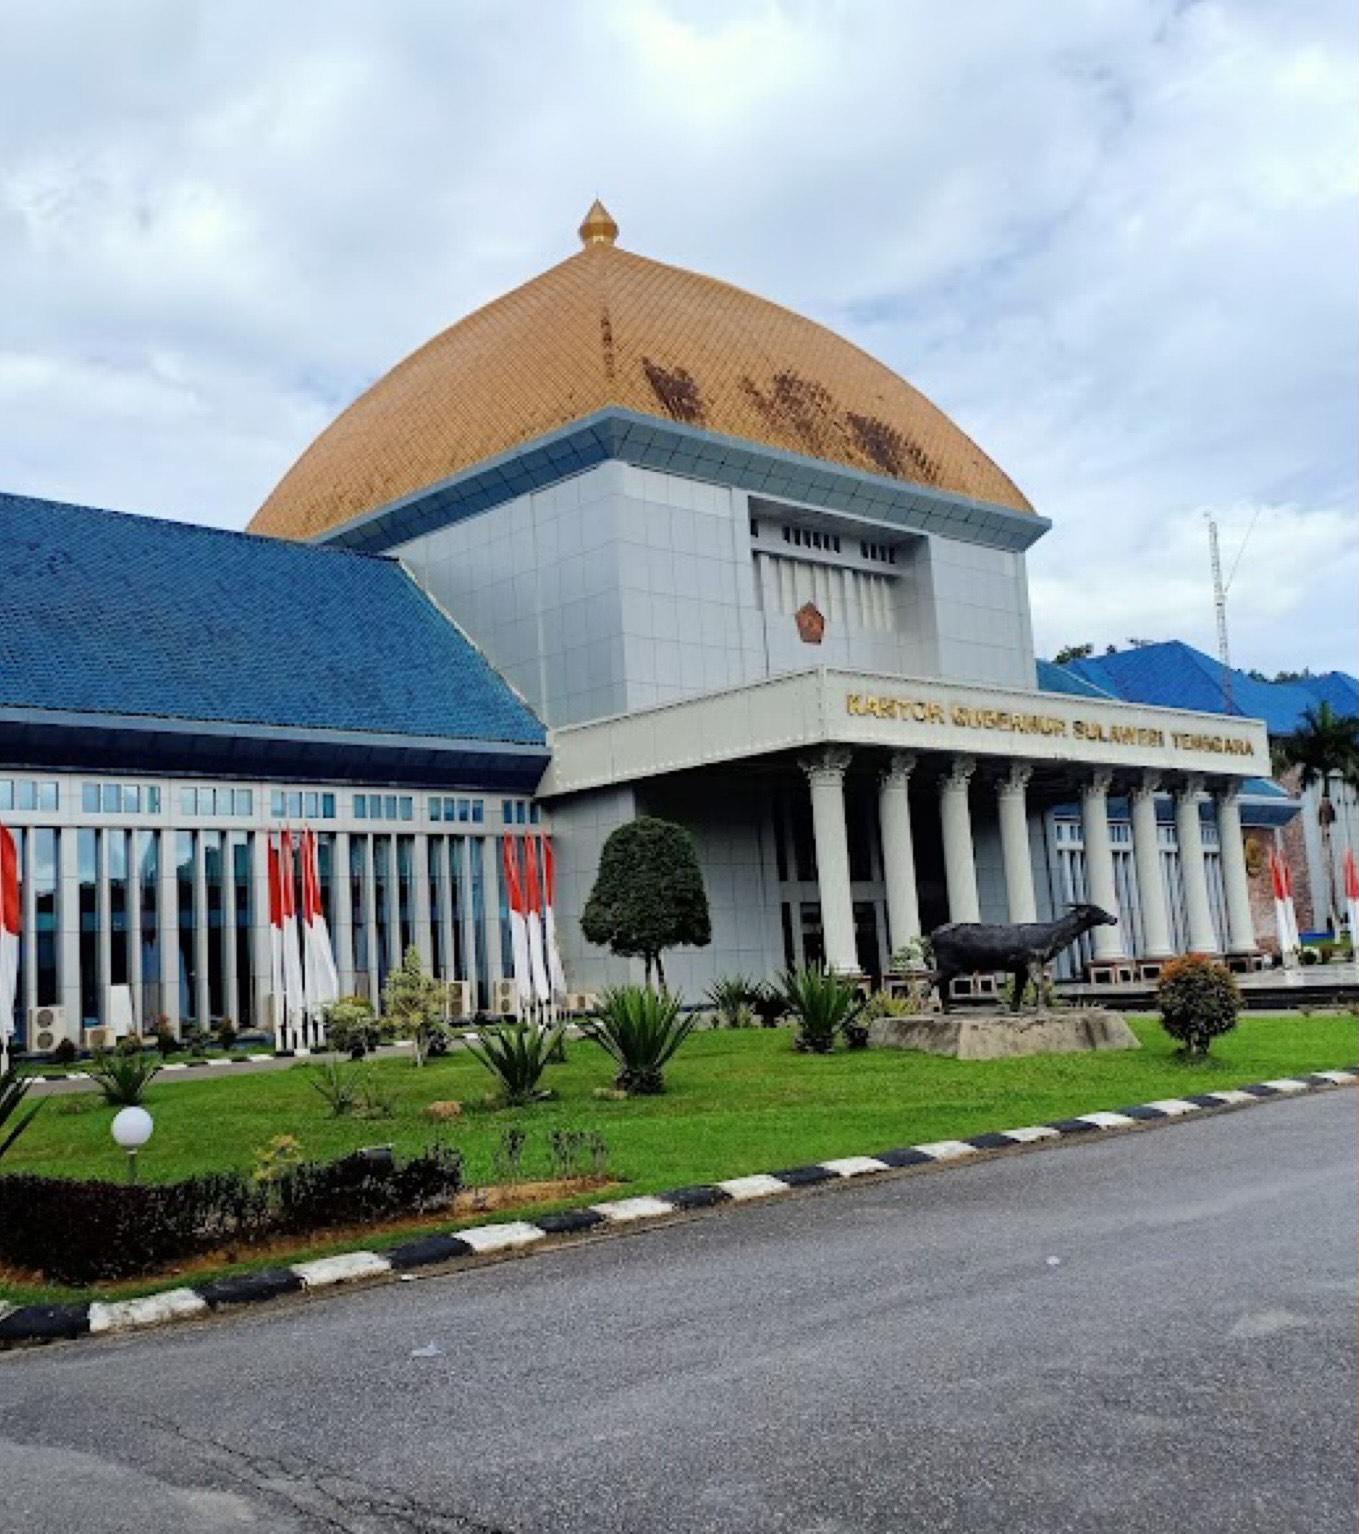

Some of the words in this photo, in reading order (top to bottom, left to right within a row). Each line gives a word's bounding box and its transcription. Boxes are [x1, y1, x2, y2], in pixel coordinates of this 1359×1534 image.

[847, 693, 945, 724] KANTOR
[952, 706, 1067, 738] GUBERNUR
[1073, 720, 1165, 748] SULAWESI
